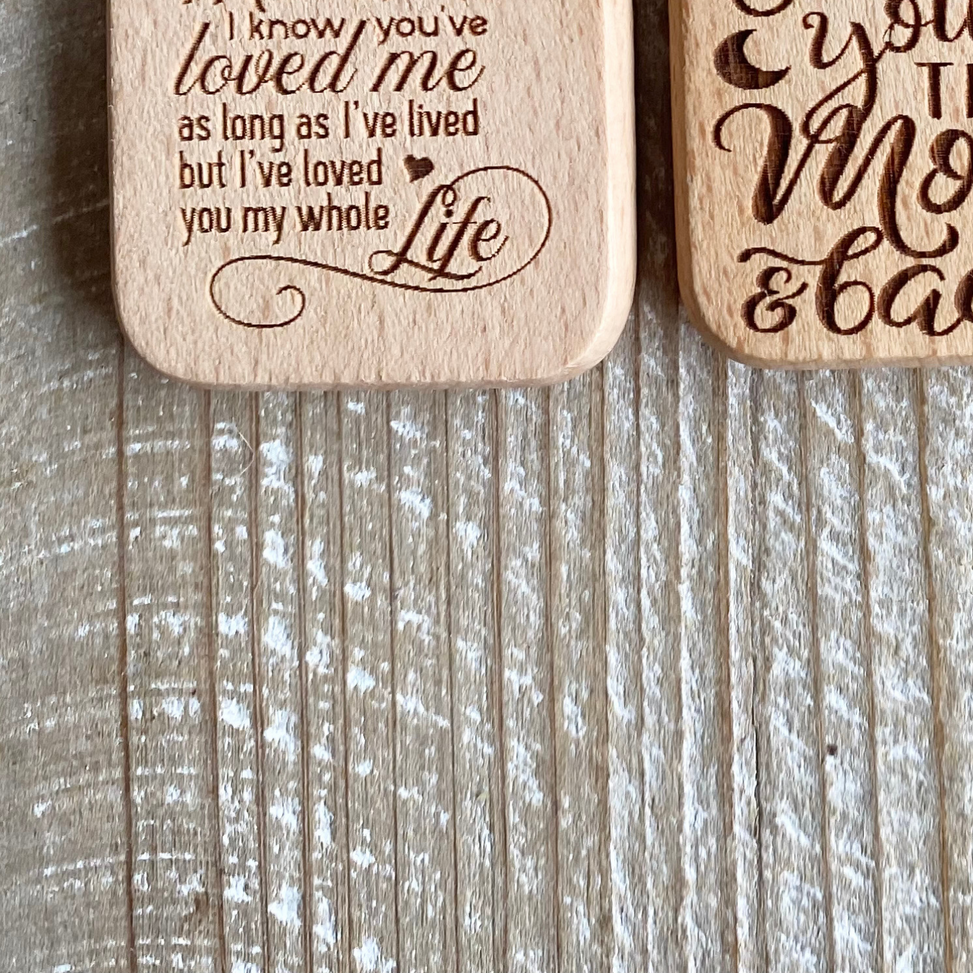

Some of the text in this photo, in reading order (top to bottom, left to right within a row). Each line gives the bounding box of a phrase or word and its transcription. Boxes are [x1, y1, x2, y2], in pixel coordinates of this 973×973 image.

[227, 5, 489, 45] I know you've
[174, 18, 486, 96] loved me
[178, 99, 481, 152] as long as I've lived
[178, 148, 383, 189] but I've loved
[179, 183, 509, 282] you my whole Life
[740, 265, 809, 333] &
